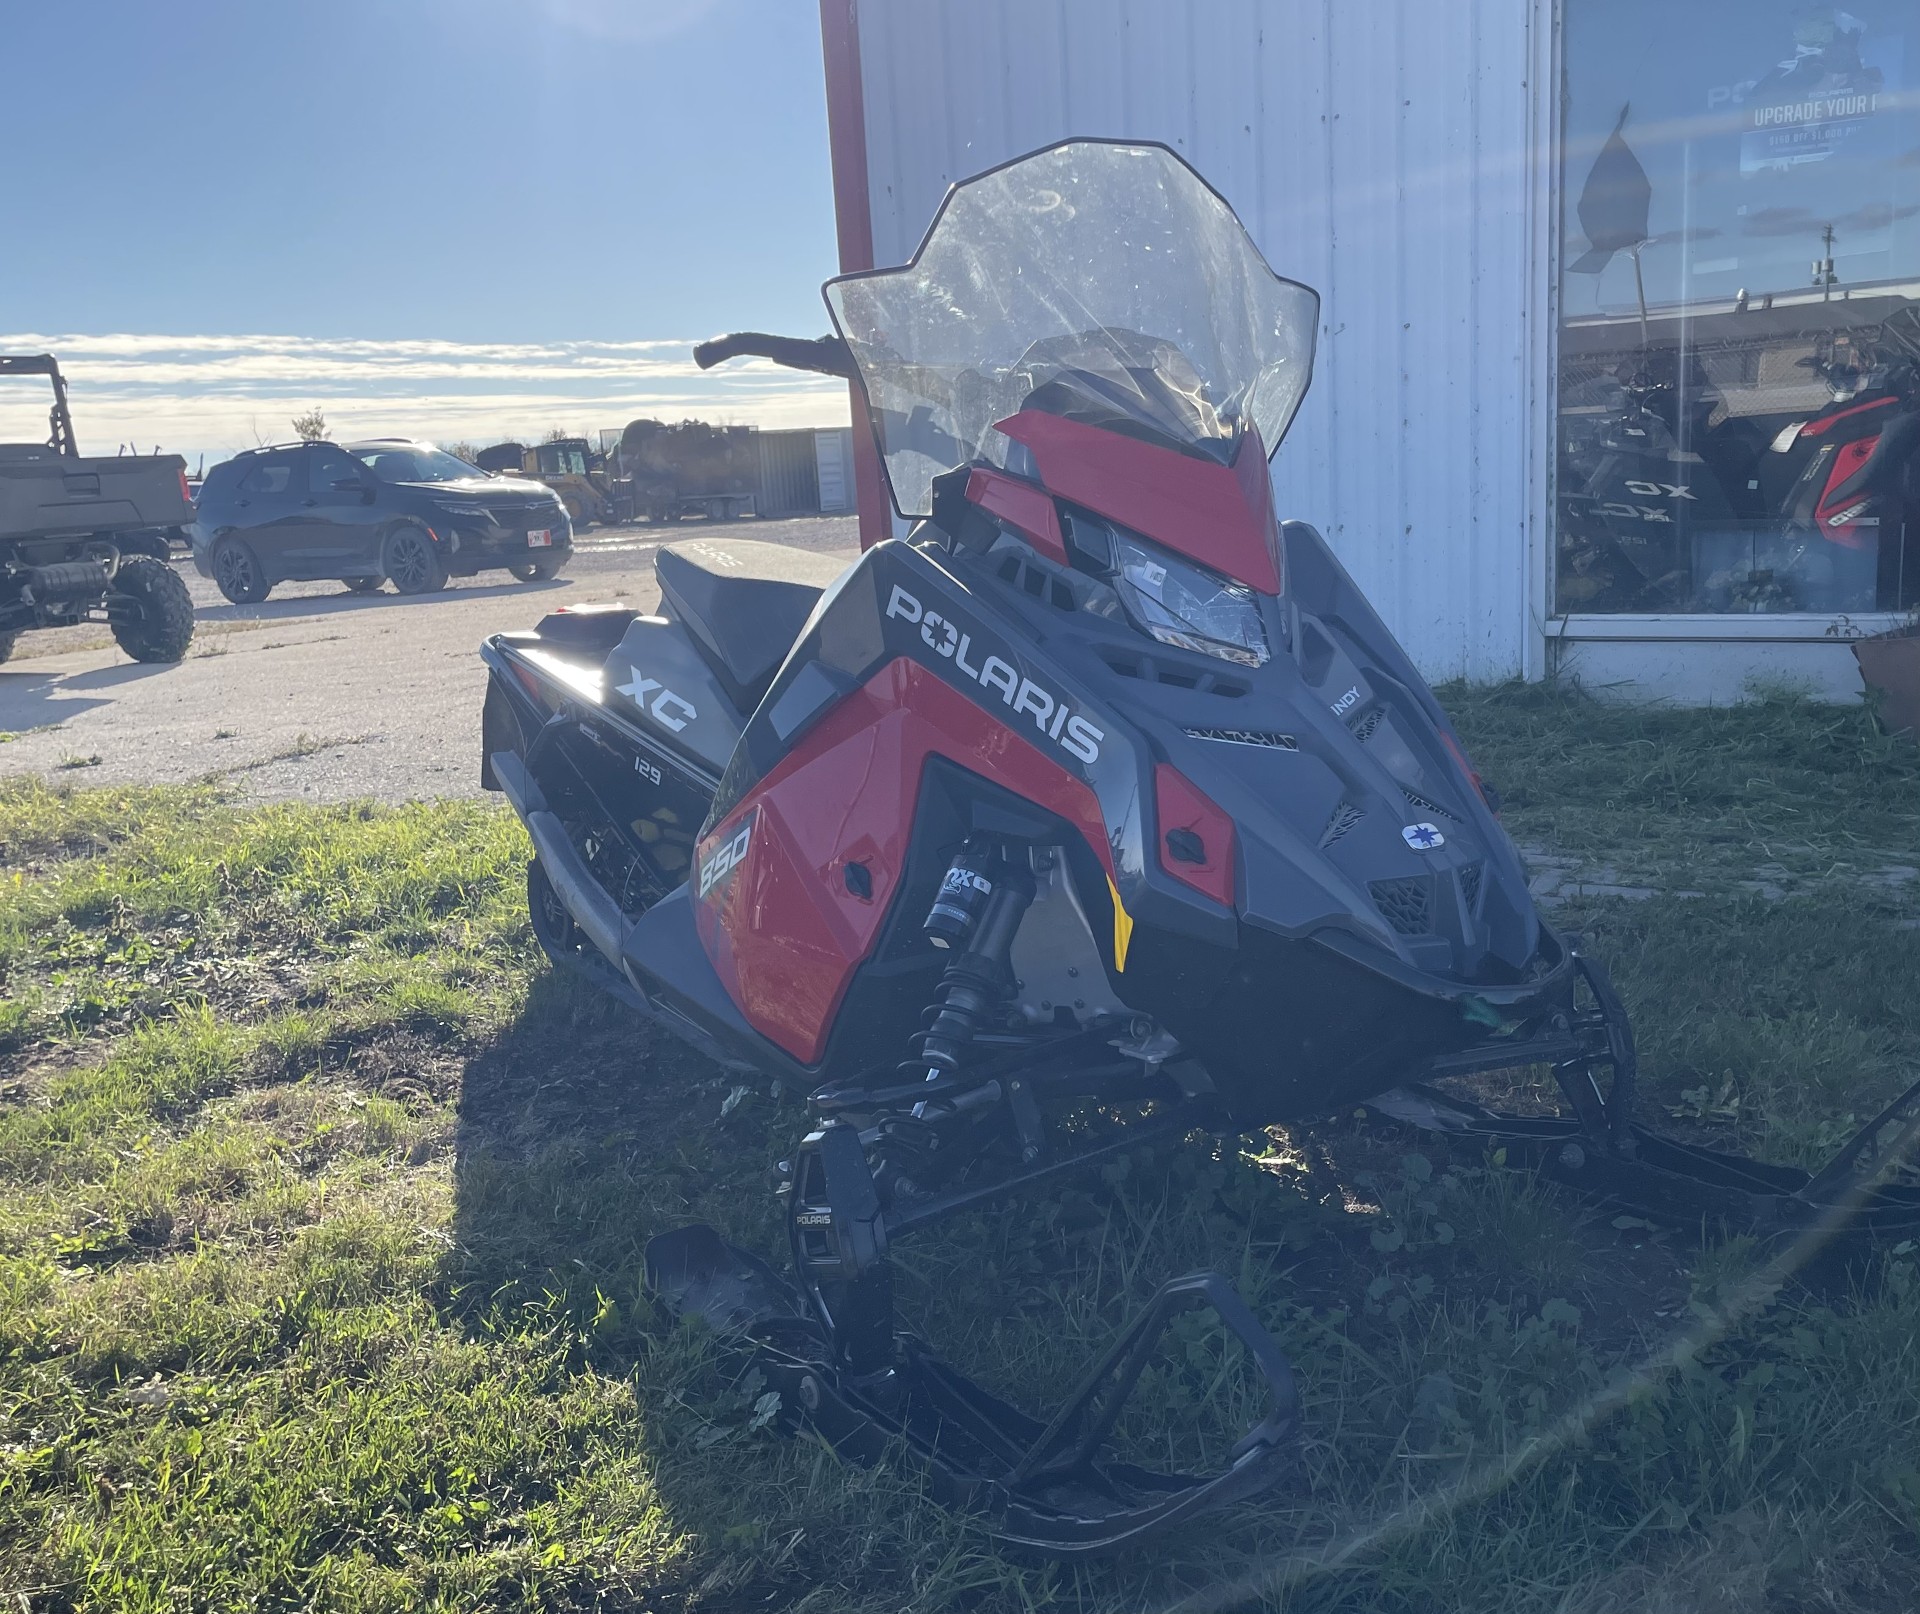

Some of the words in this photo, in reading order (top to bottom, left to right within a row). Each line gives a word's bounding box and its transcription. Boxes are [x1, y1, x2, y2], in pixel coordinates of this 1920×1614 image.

[1754, 100, 1822, 126] UPGRADE
[1826, 95, 1867, 118] YOUR
[886, 584, 1105, 764] POLARIS
[614, 665, 697, 733] XC
[1330, 686, 1361, 716] INDY
[634, 756, 661, 786] 129
[700, 827, 750, 899] 850
[796, 1214, 831, 1225] POLARIS
